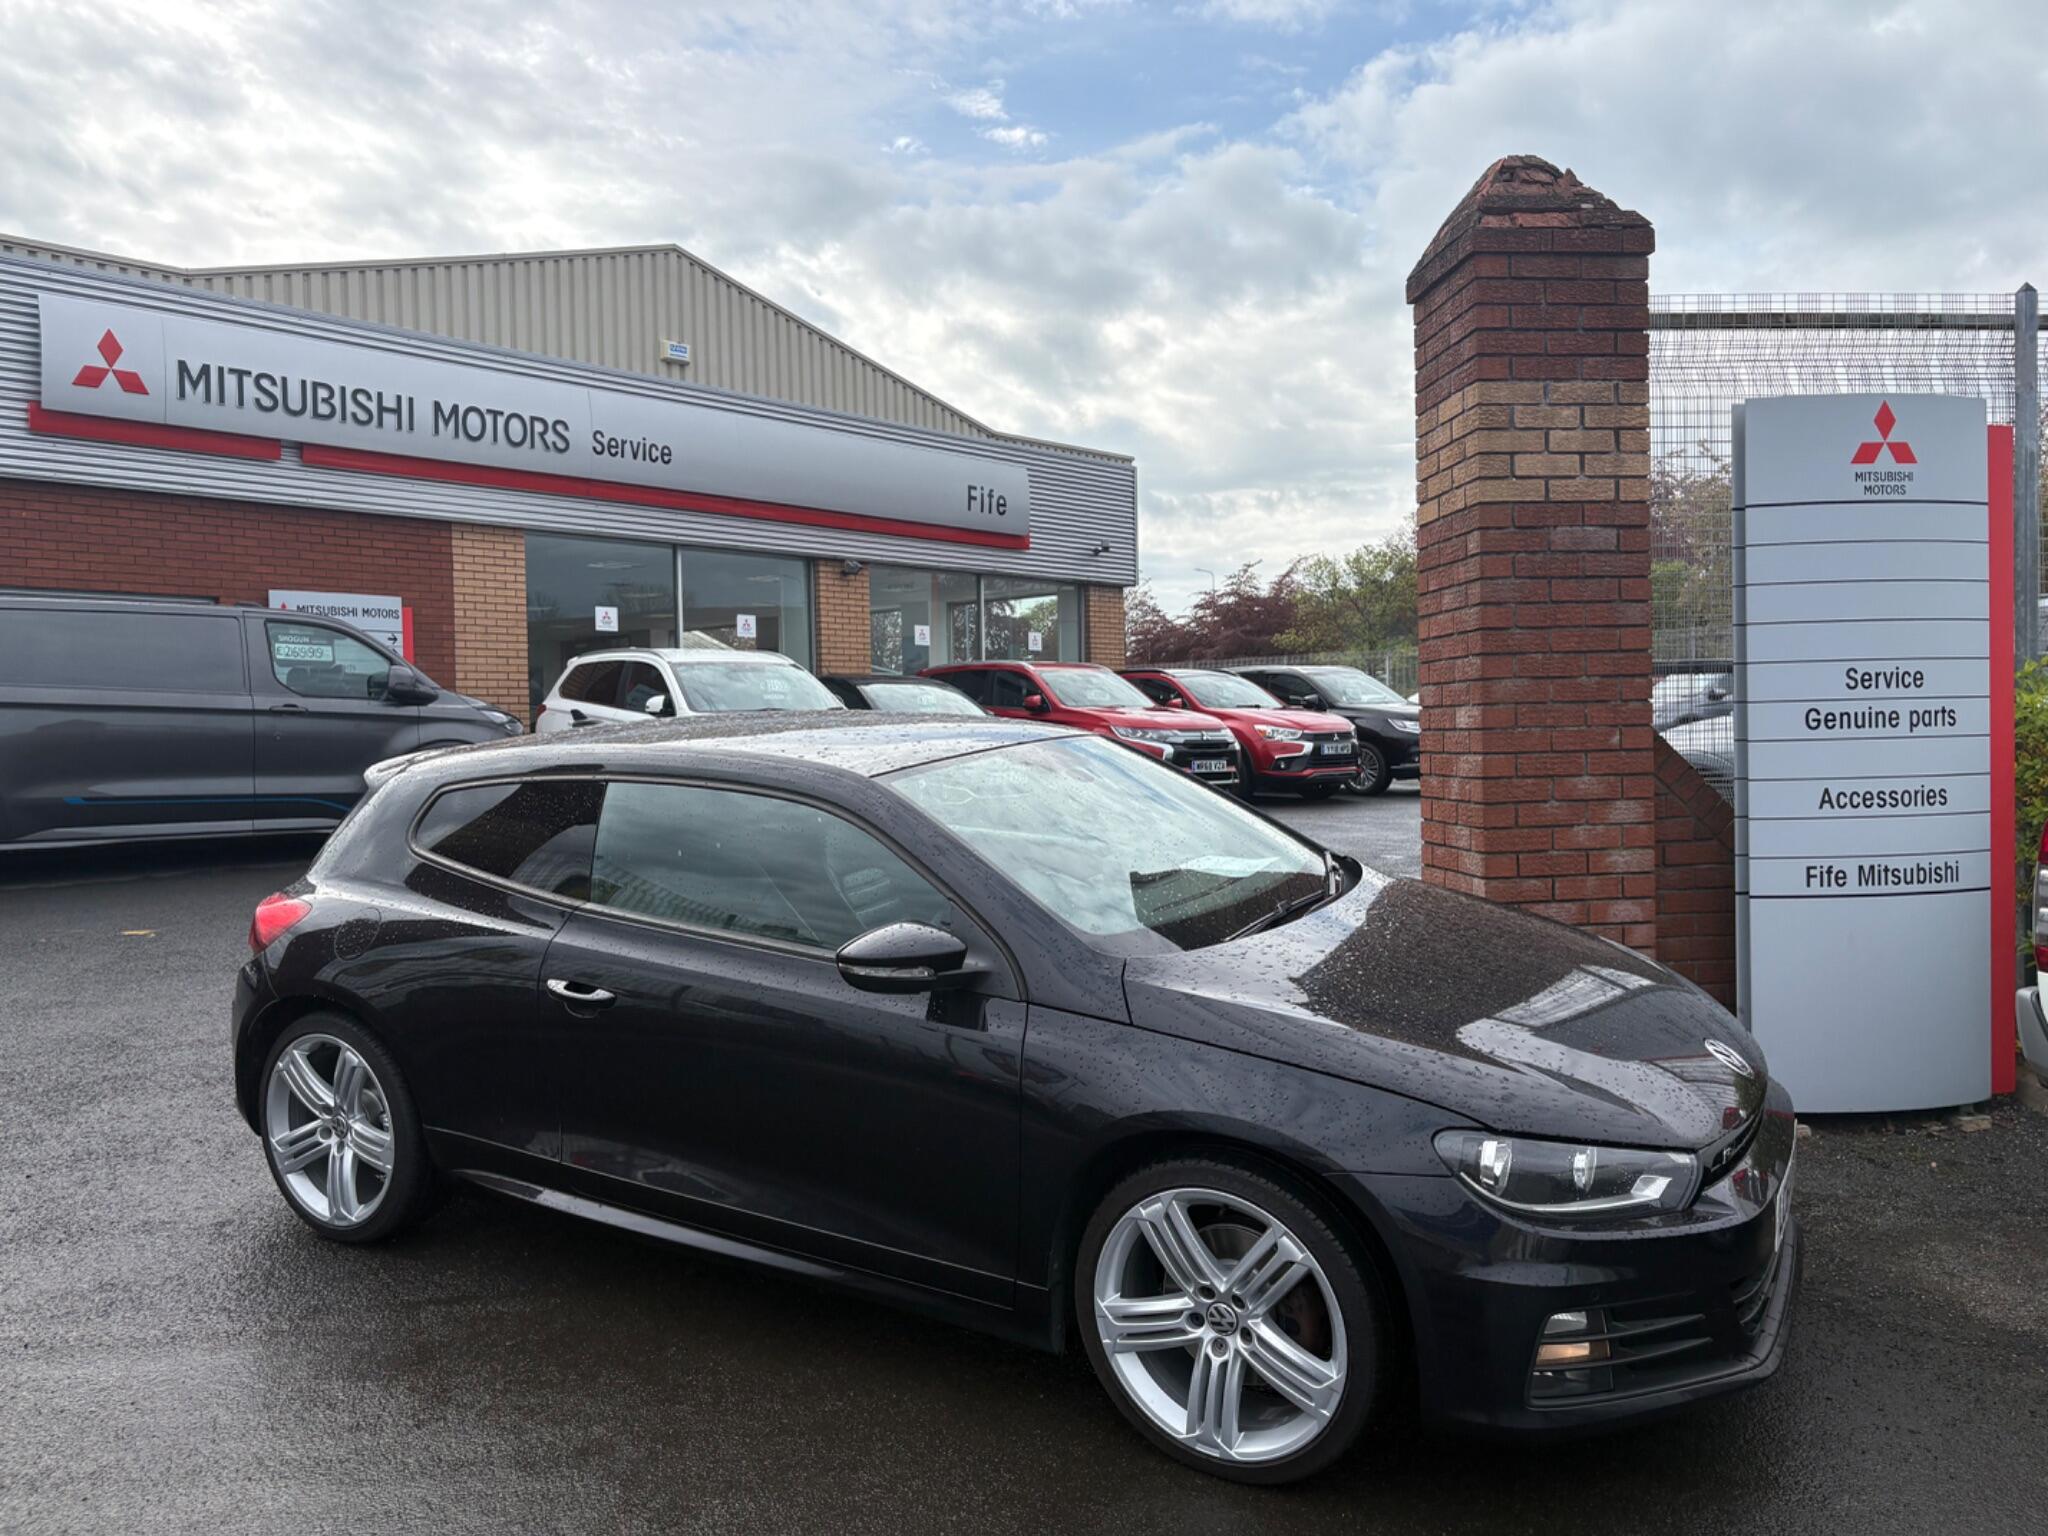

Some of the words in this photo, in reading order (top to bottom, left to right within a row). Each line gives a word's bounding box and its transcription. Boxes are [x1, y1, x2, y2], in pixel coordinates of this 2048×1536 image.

[177, 359, 415, 432] MITSUBISHI
[433, 399, 571, 454] MOTORS
[591, 429, 673, 465] Service
[1855, 471, 1914, 482] MITSUBISHI
[967, 484, 1007, 516] Fife
[1863, 484, 1907, 496] MOTORS
[296, 604, 358, 618] MITSUBISHI
[362, 607, 400, 620] MOTORS
[1845, 666, 1924, 690] Service
[1805, 706, 1900, 731] Genuine
[1909, 705, 1957, 733] parts
[1818, 784, 1948, 810] Accessories
[1805, 864, 1848, 888] Fife
[1858, 860, 1960, 887] Mitsubishi
